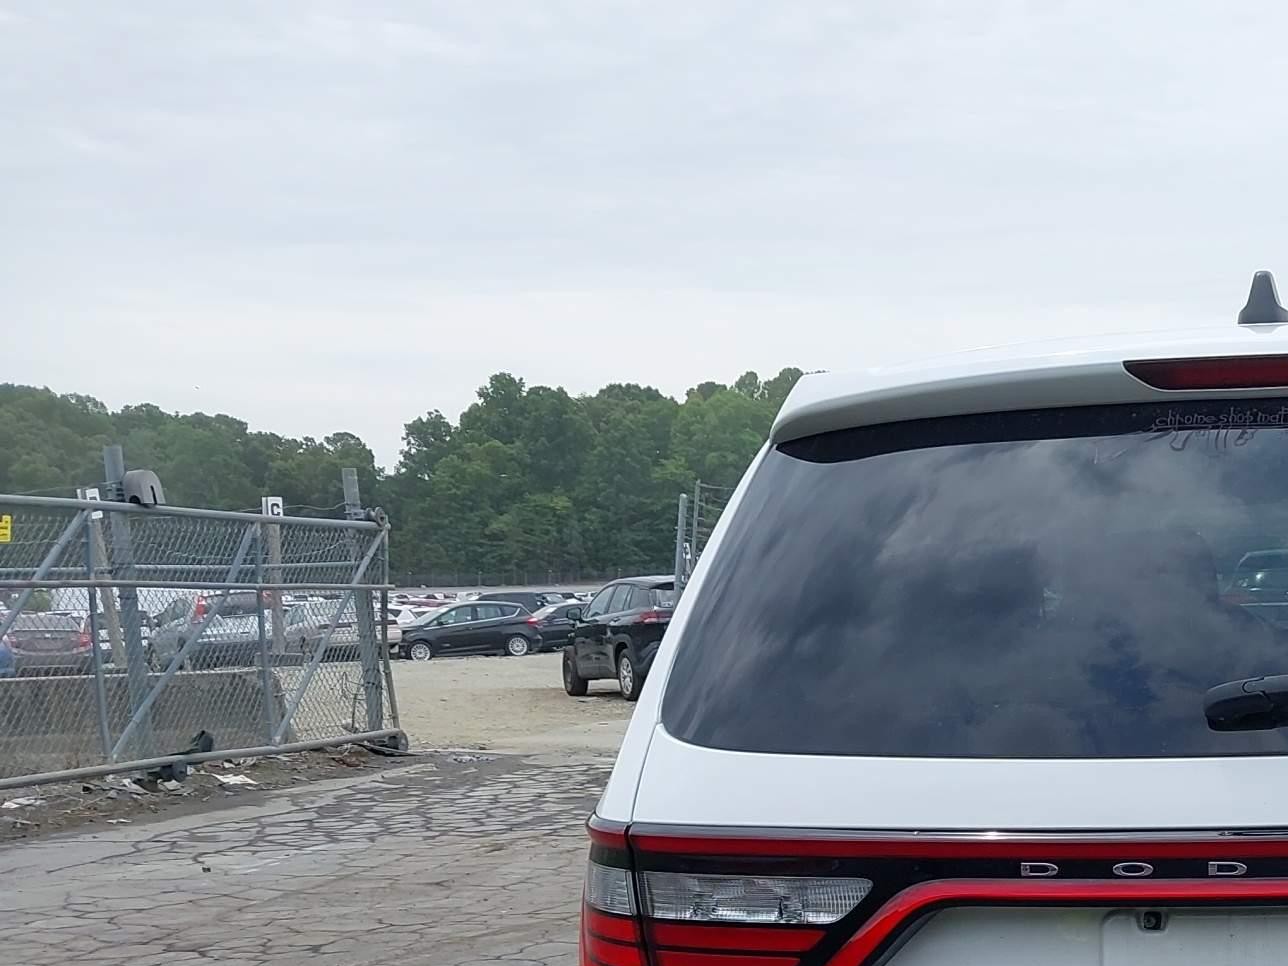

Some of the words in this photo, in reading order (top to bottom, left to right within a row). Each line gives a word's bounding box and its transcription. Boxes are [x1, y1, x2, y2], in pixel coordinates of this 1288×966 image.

[1155, 409, 1217, 429] chrome
[1218, 406, 1254, 427] shop
[270, 502, 281, 517] C
